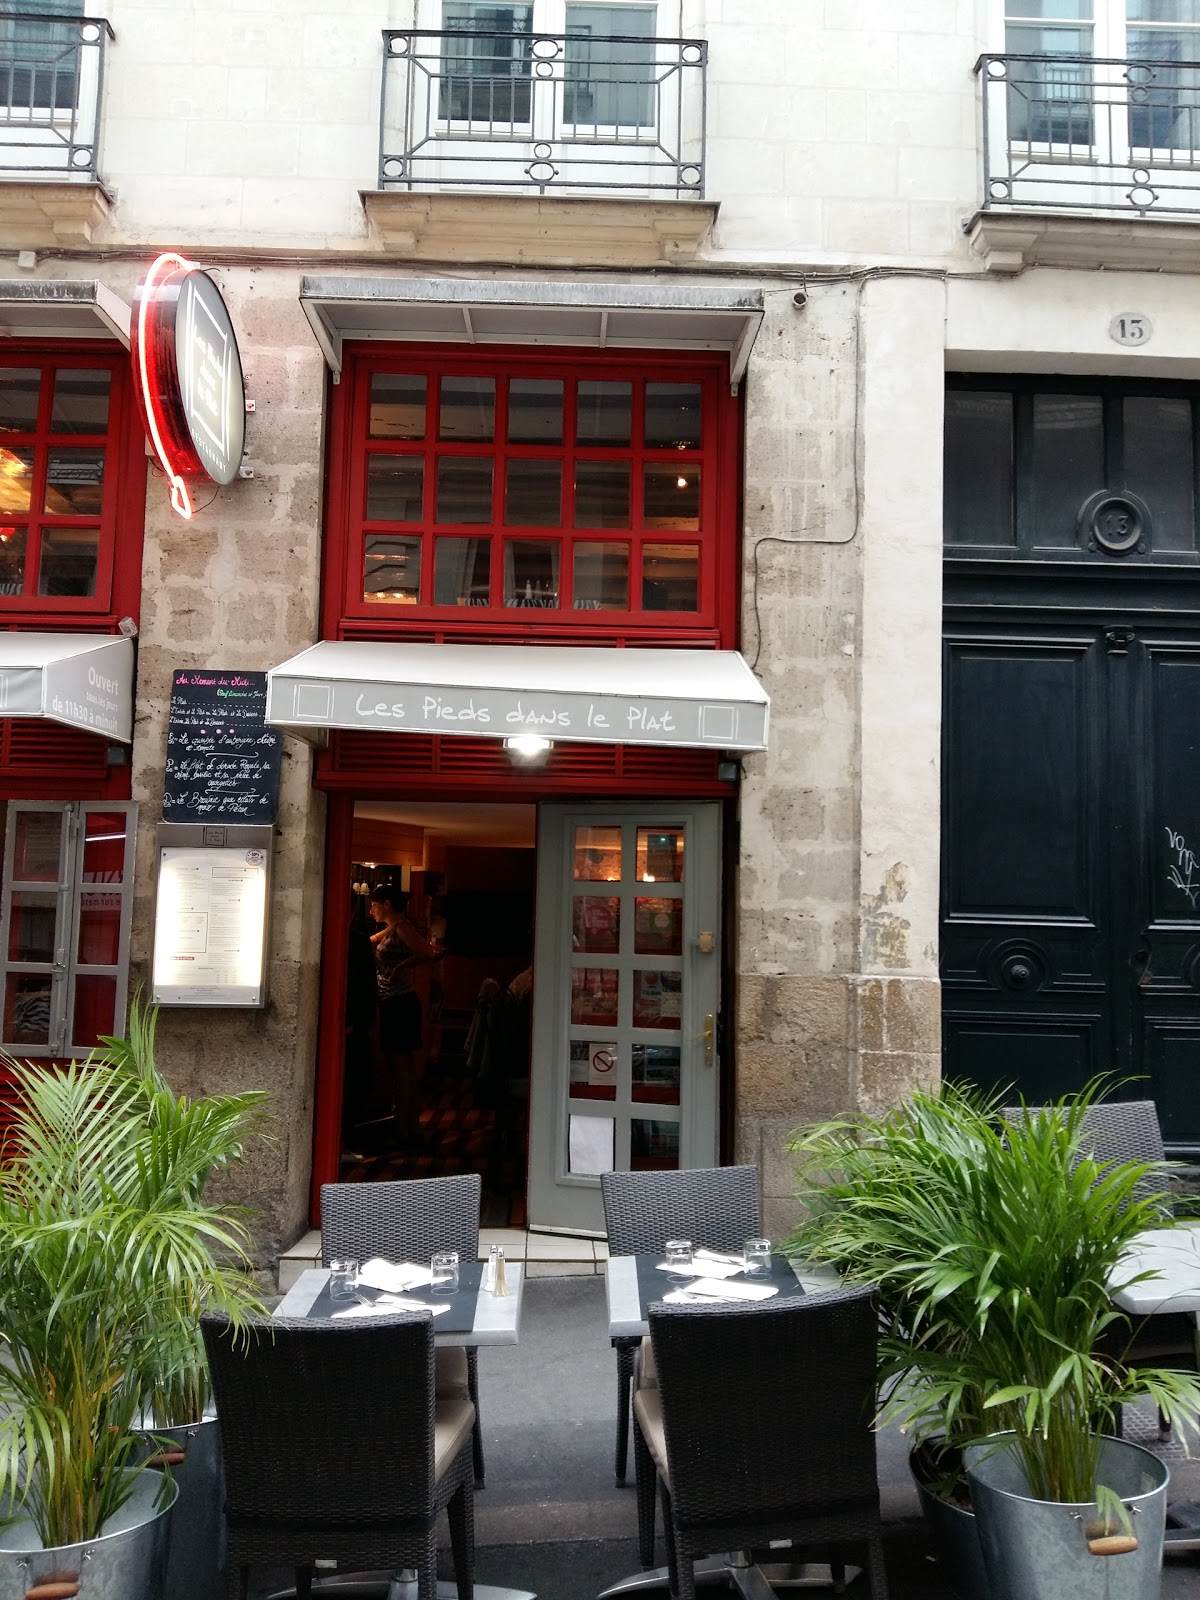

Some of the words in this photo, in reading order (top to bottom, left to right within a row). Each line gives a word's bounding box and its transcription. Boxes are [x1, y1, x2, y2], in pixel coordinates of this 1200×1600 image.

[1118, 318, 1144, 339] 13
[191, 427, 226, 473] RESTAURANT
[1105, 514, 1129, 536] 13
[88, 666, 118, 696] Ouvert
[52, 695, 63, 713] de
[65, 700, 88, 722] 11h30
[89, 708, 94, 724] à
[95, 713, 118, 733] minuit
[86, 691, 98, 704] tous
[98, 696, 106, 707] les
[105, 698, 118, 712] jours
[355, 693, 406, 718] Les
[422, 695, 491, 723] Pieds
[587, 703, 610, 728] le
